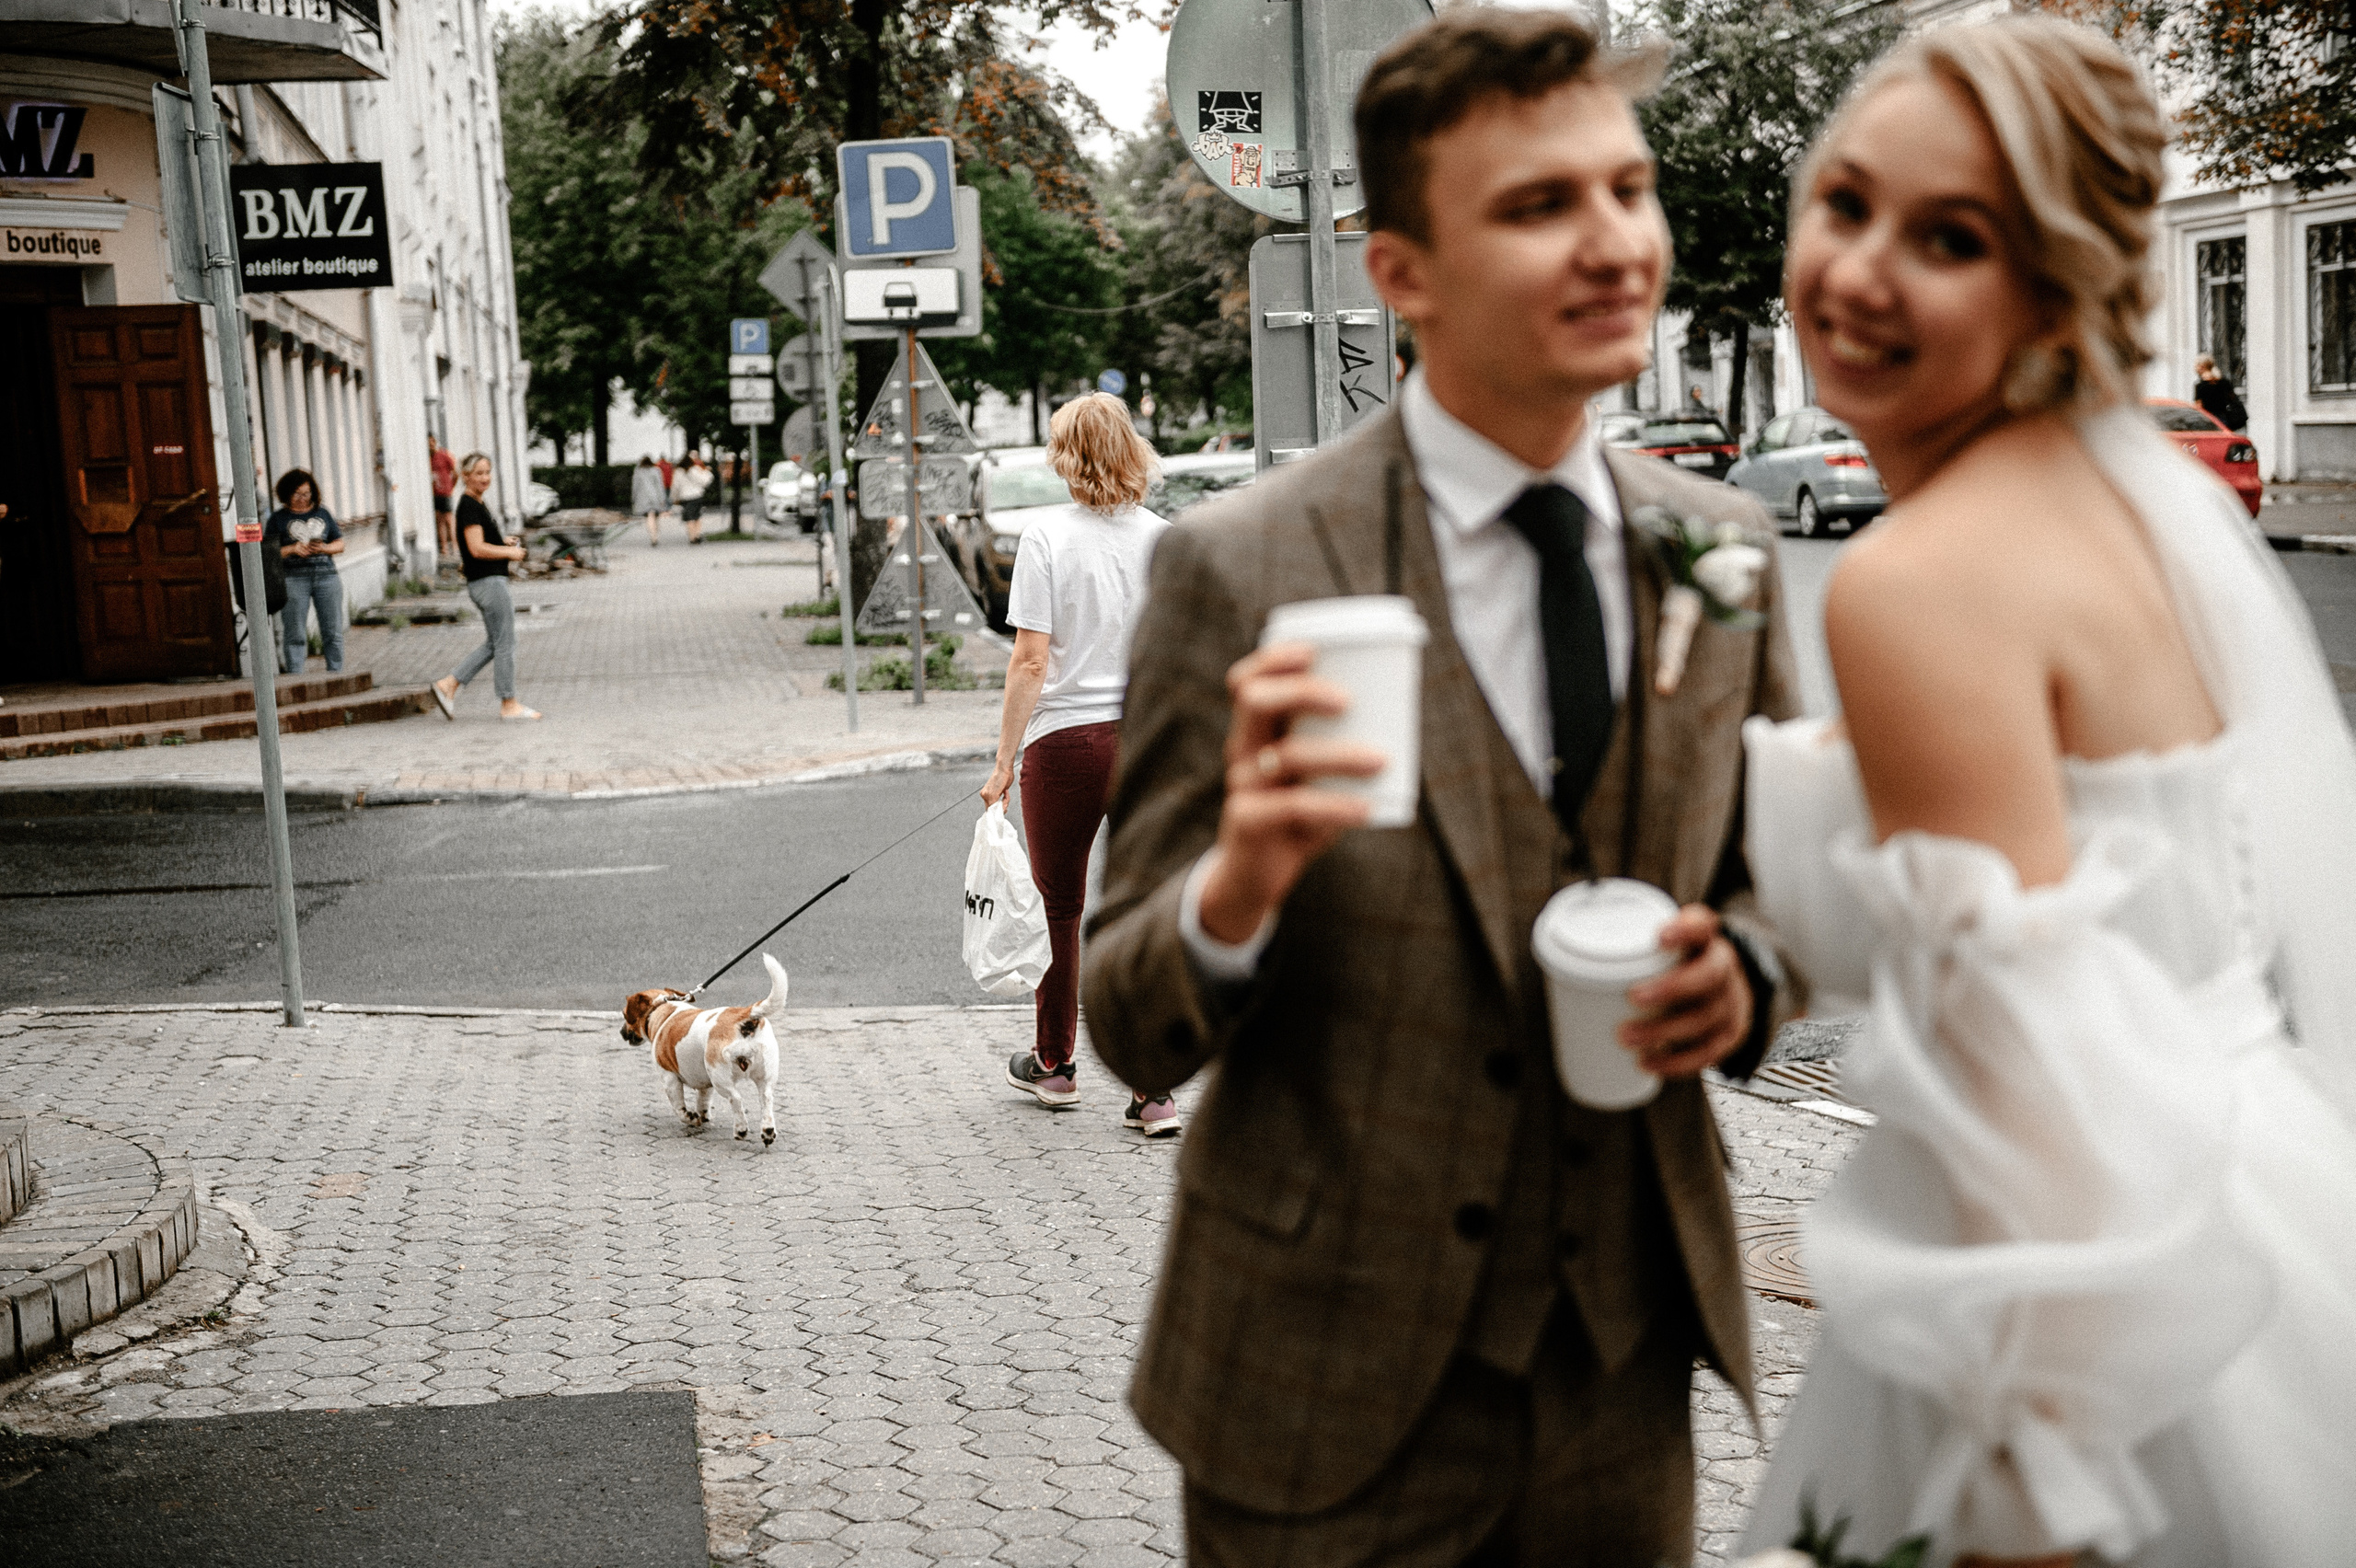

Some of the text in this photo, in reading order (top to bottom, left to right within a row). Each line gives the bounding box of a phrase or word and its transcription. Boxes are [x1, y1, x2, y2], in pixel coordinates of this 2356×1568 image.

[238, 186, 374, 240] BMZ
[867, 151, 938, 246] P
[6, 230, 101, 259] boutique
[245, 256, 379, 277] atelier boutique
[739, 323, 762, 352] P
